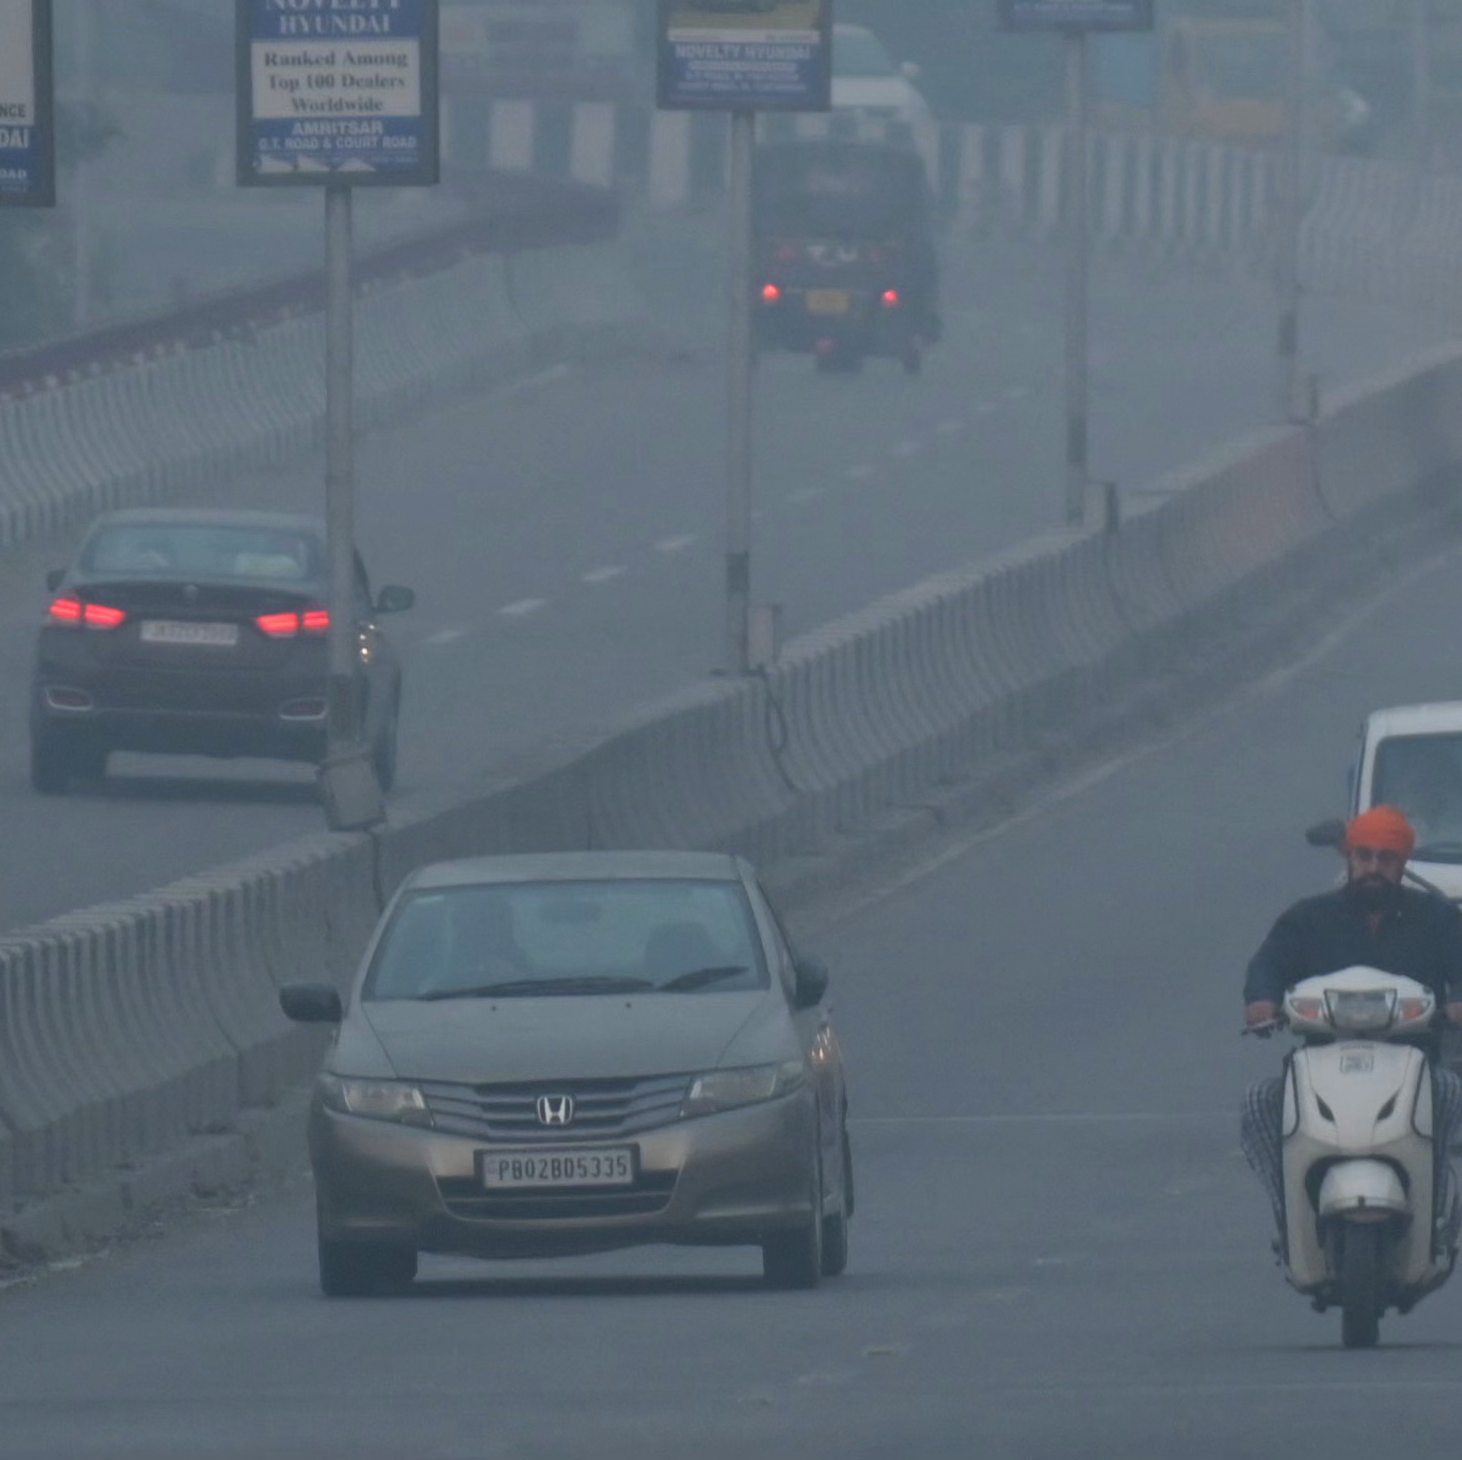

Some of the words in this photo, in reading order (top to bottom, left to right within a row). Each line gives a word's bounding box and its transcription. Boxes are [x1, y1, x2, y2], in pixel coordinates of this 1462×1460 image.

[279, 14, 390, 34] HYUNDAI
[264, 50, 336, 67] Ranked
[343, 50, 409, 68] Among
[269, 74, 300, 93] Top
[307, 74, 335, 89] 100
[342, 72, 406, 89] Dealers
[291, 96, 384, 113] Worldwide
[292, 120, 384, 136] AMRITSAR
[284, 136, 319, 149] ROAD
[335, 136, 378, 149] COURT
[382, 135, 417, 149] ROAD
[498, 1155, 628, 1181] PB02BD5335
